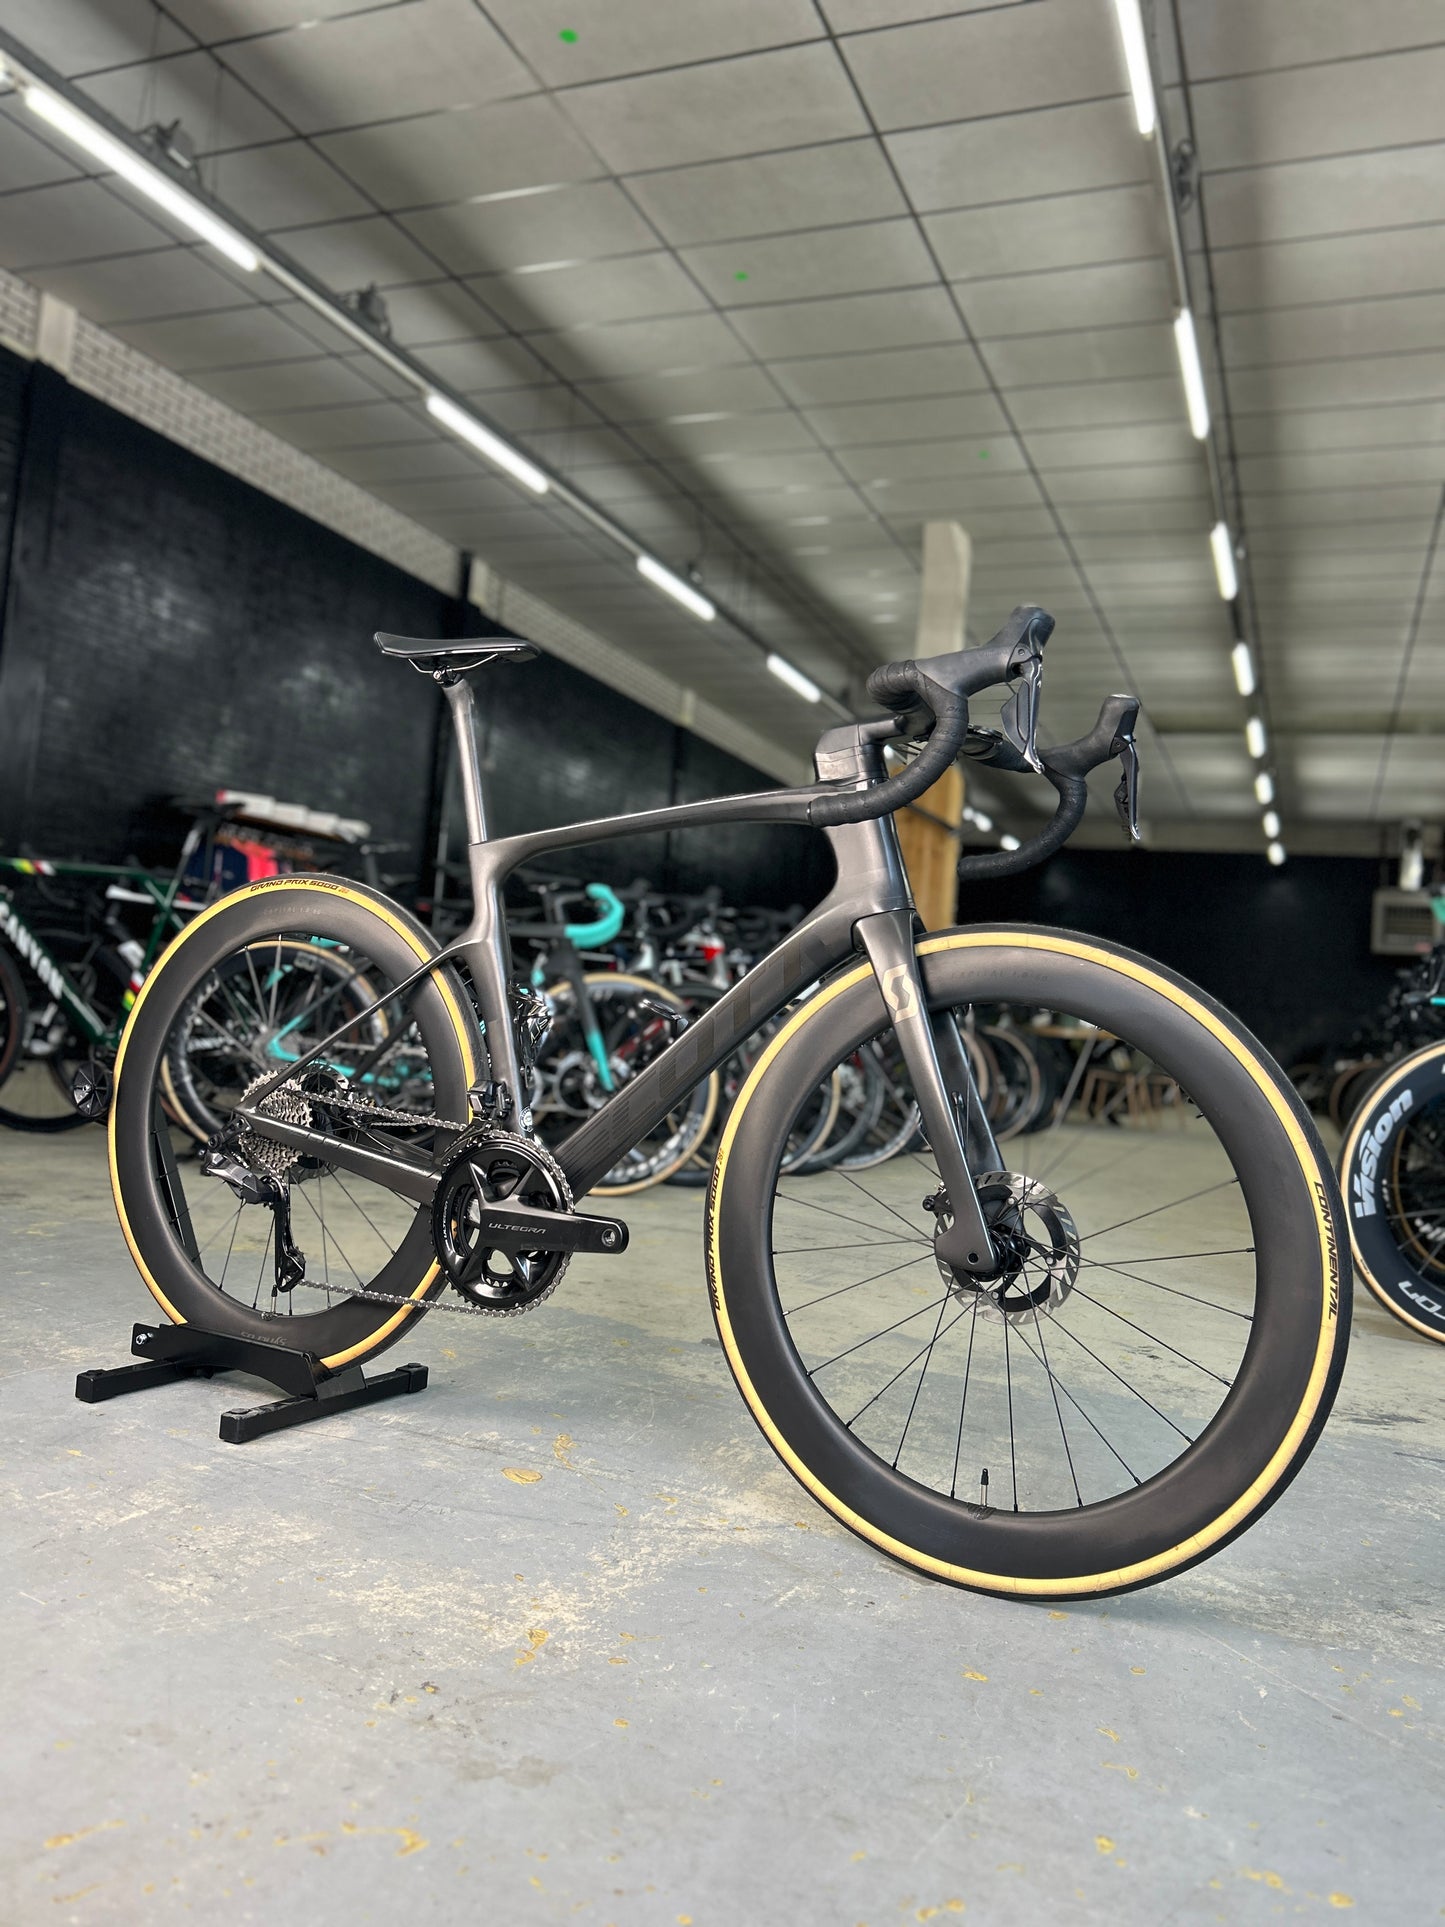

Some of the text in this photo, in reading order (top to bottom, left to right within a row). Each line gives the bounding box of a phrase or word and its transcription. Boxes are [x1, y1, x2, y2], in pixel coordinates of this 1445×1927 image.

[250, 879, 284, 893] GRAND
[284, 878, 310, 886] PRIX
[309, 880, 339, 892] 5000
[1353, 1087, 1414, 1219] Vision
[709, 1165, 721, 1213] 5000
[488, 1222, 547, 1235] ULTEGRA
[1313, 1180, 1339, 1321] CONTINENTAL
[708, 1257, 721, 1312] GRAND
